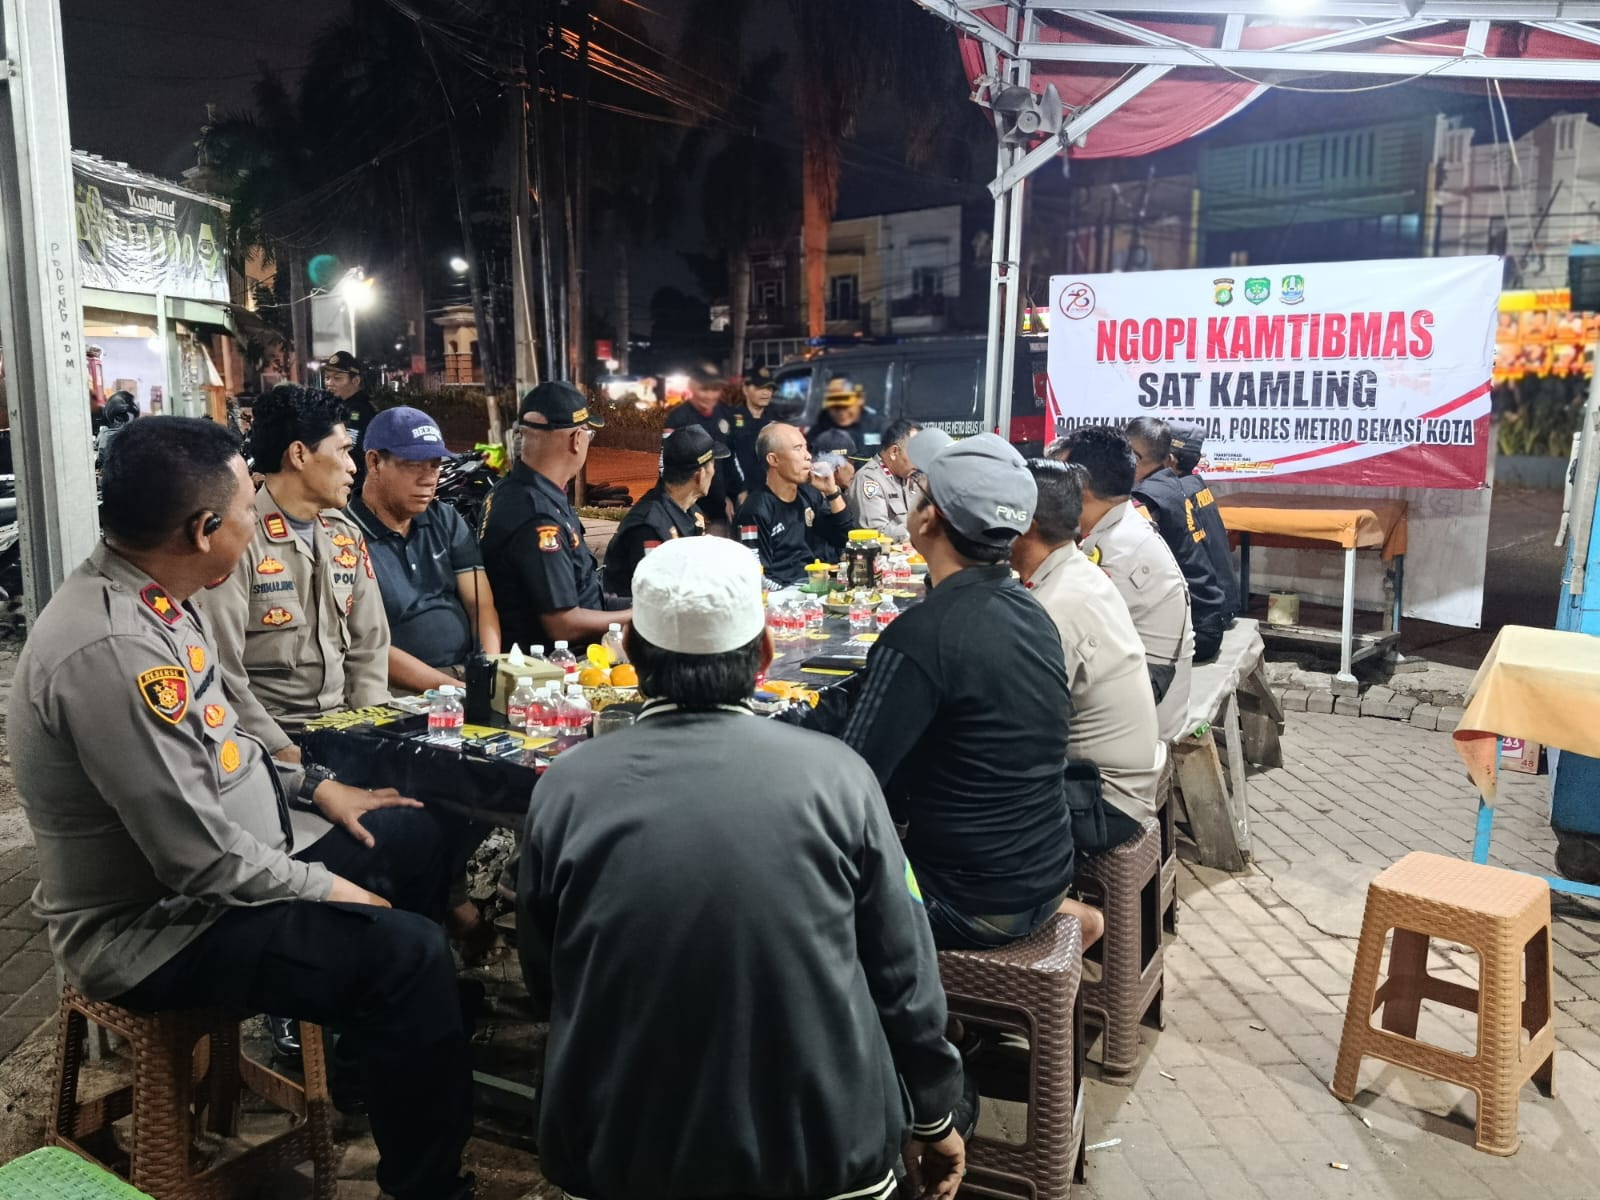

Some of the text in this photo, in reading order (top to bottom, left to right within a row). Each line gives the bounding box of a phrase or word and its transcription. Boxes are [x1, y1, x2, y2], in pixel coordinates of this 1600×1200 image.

[1096, 309, 1434, 362] NGOPI KAMTIBMAS
[1138, 369, 1378, 409] SAT KAMLING
[1229, 417, 1290, 441] POLRES
[1294, 418, 1353, 442] METRO
[1357, 418, 1423, 443] BEKASI
[1426, 419, 1474, 444] KOTA
[995, 505, 1027, 521] PING
[1520, 759, 1534, 768] 48
